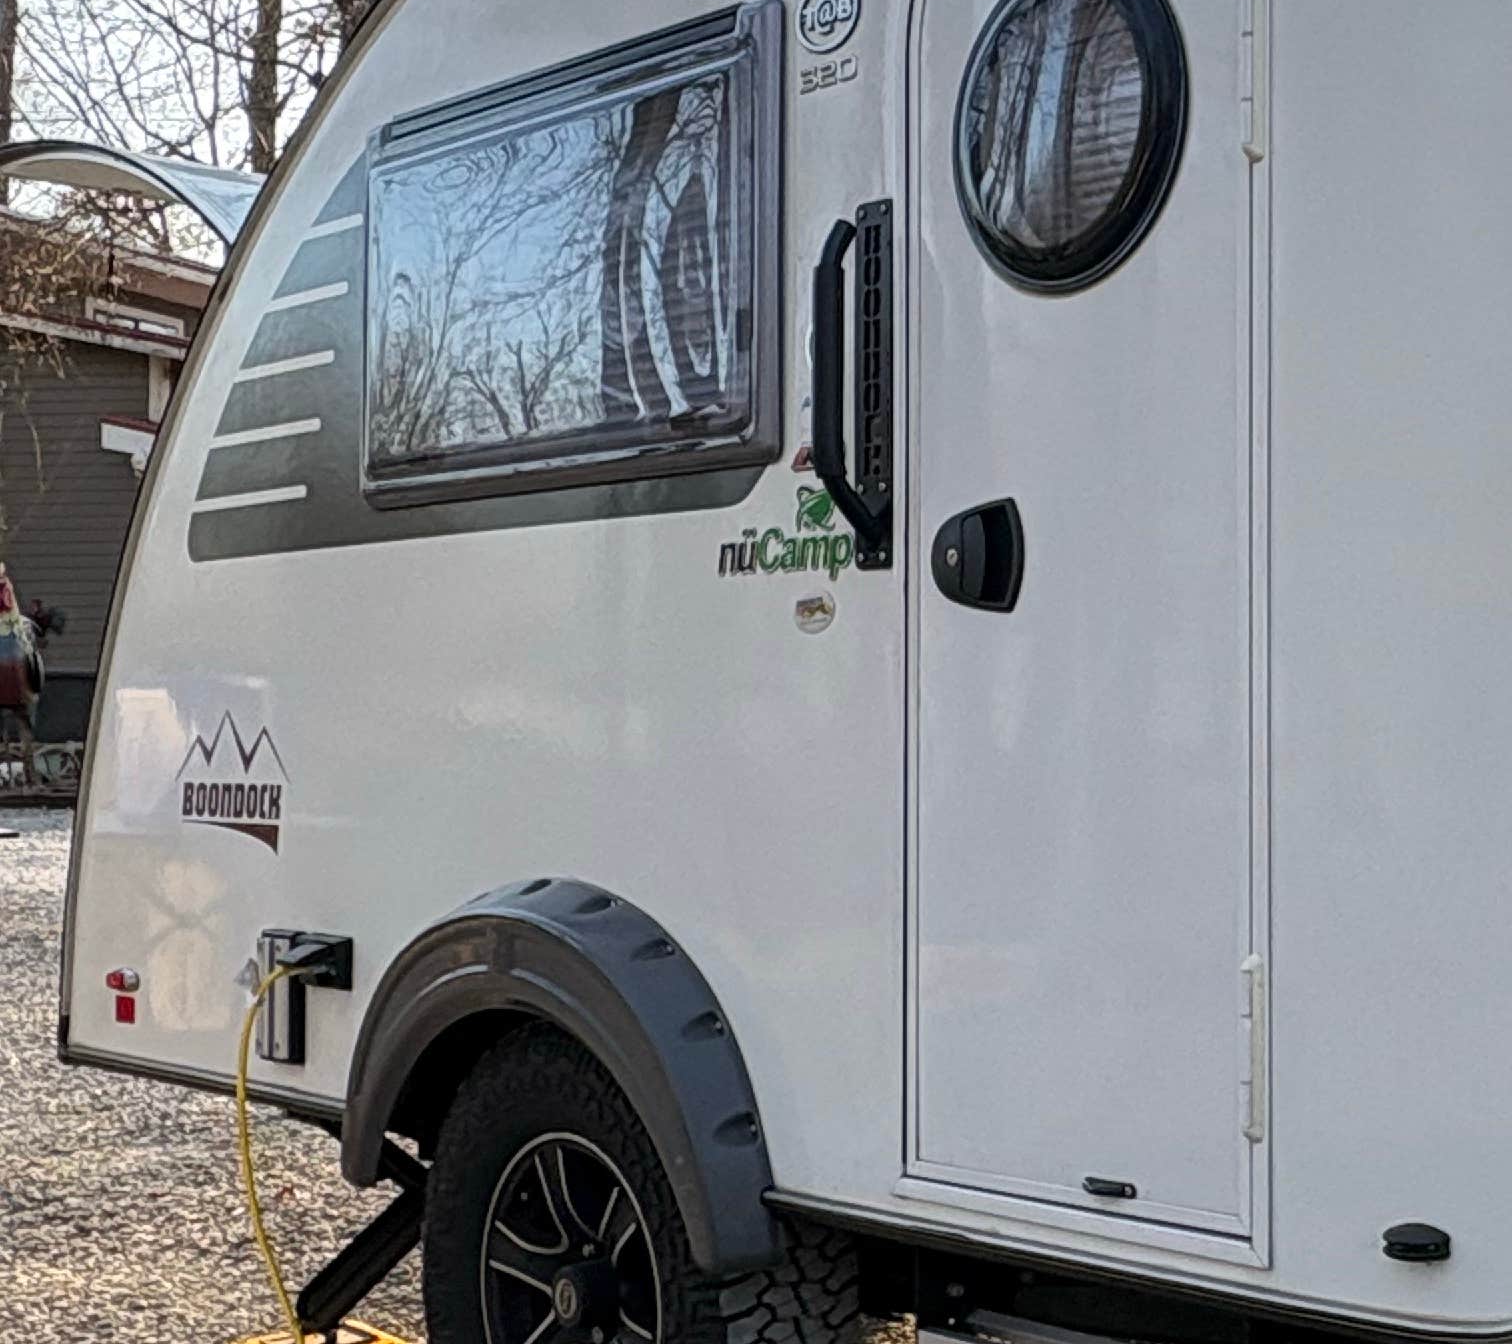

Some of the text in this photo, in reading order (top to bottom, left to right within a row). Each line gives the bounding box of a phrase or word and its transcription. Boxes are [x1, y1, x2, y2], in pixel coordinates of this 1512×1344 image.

[799, 55, 858, 96] 320
[718, 526, 855, 582] nüCamp
[182, 782, 282, 820] BOONDOCK
